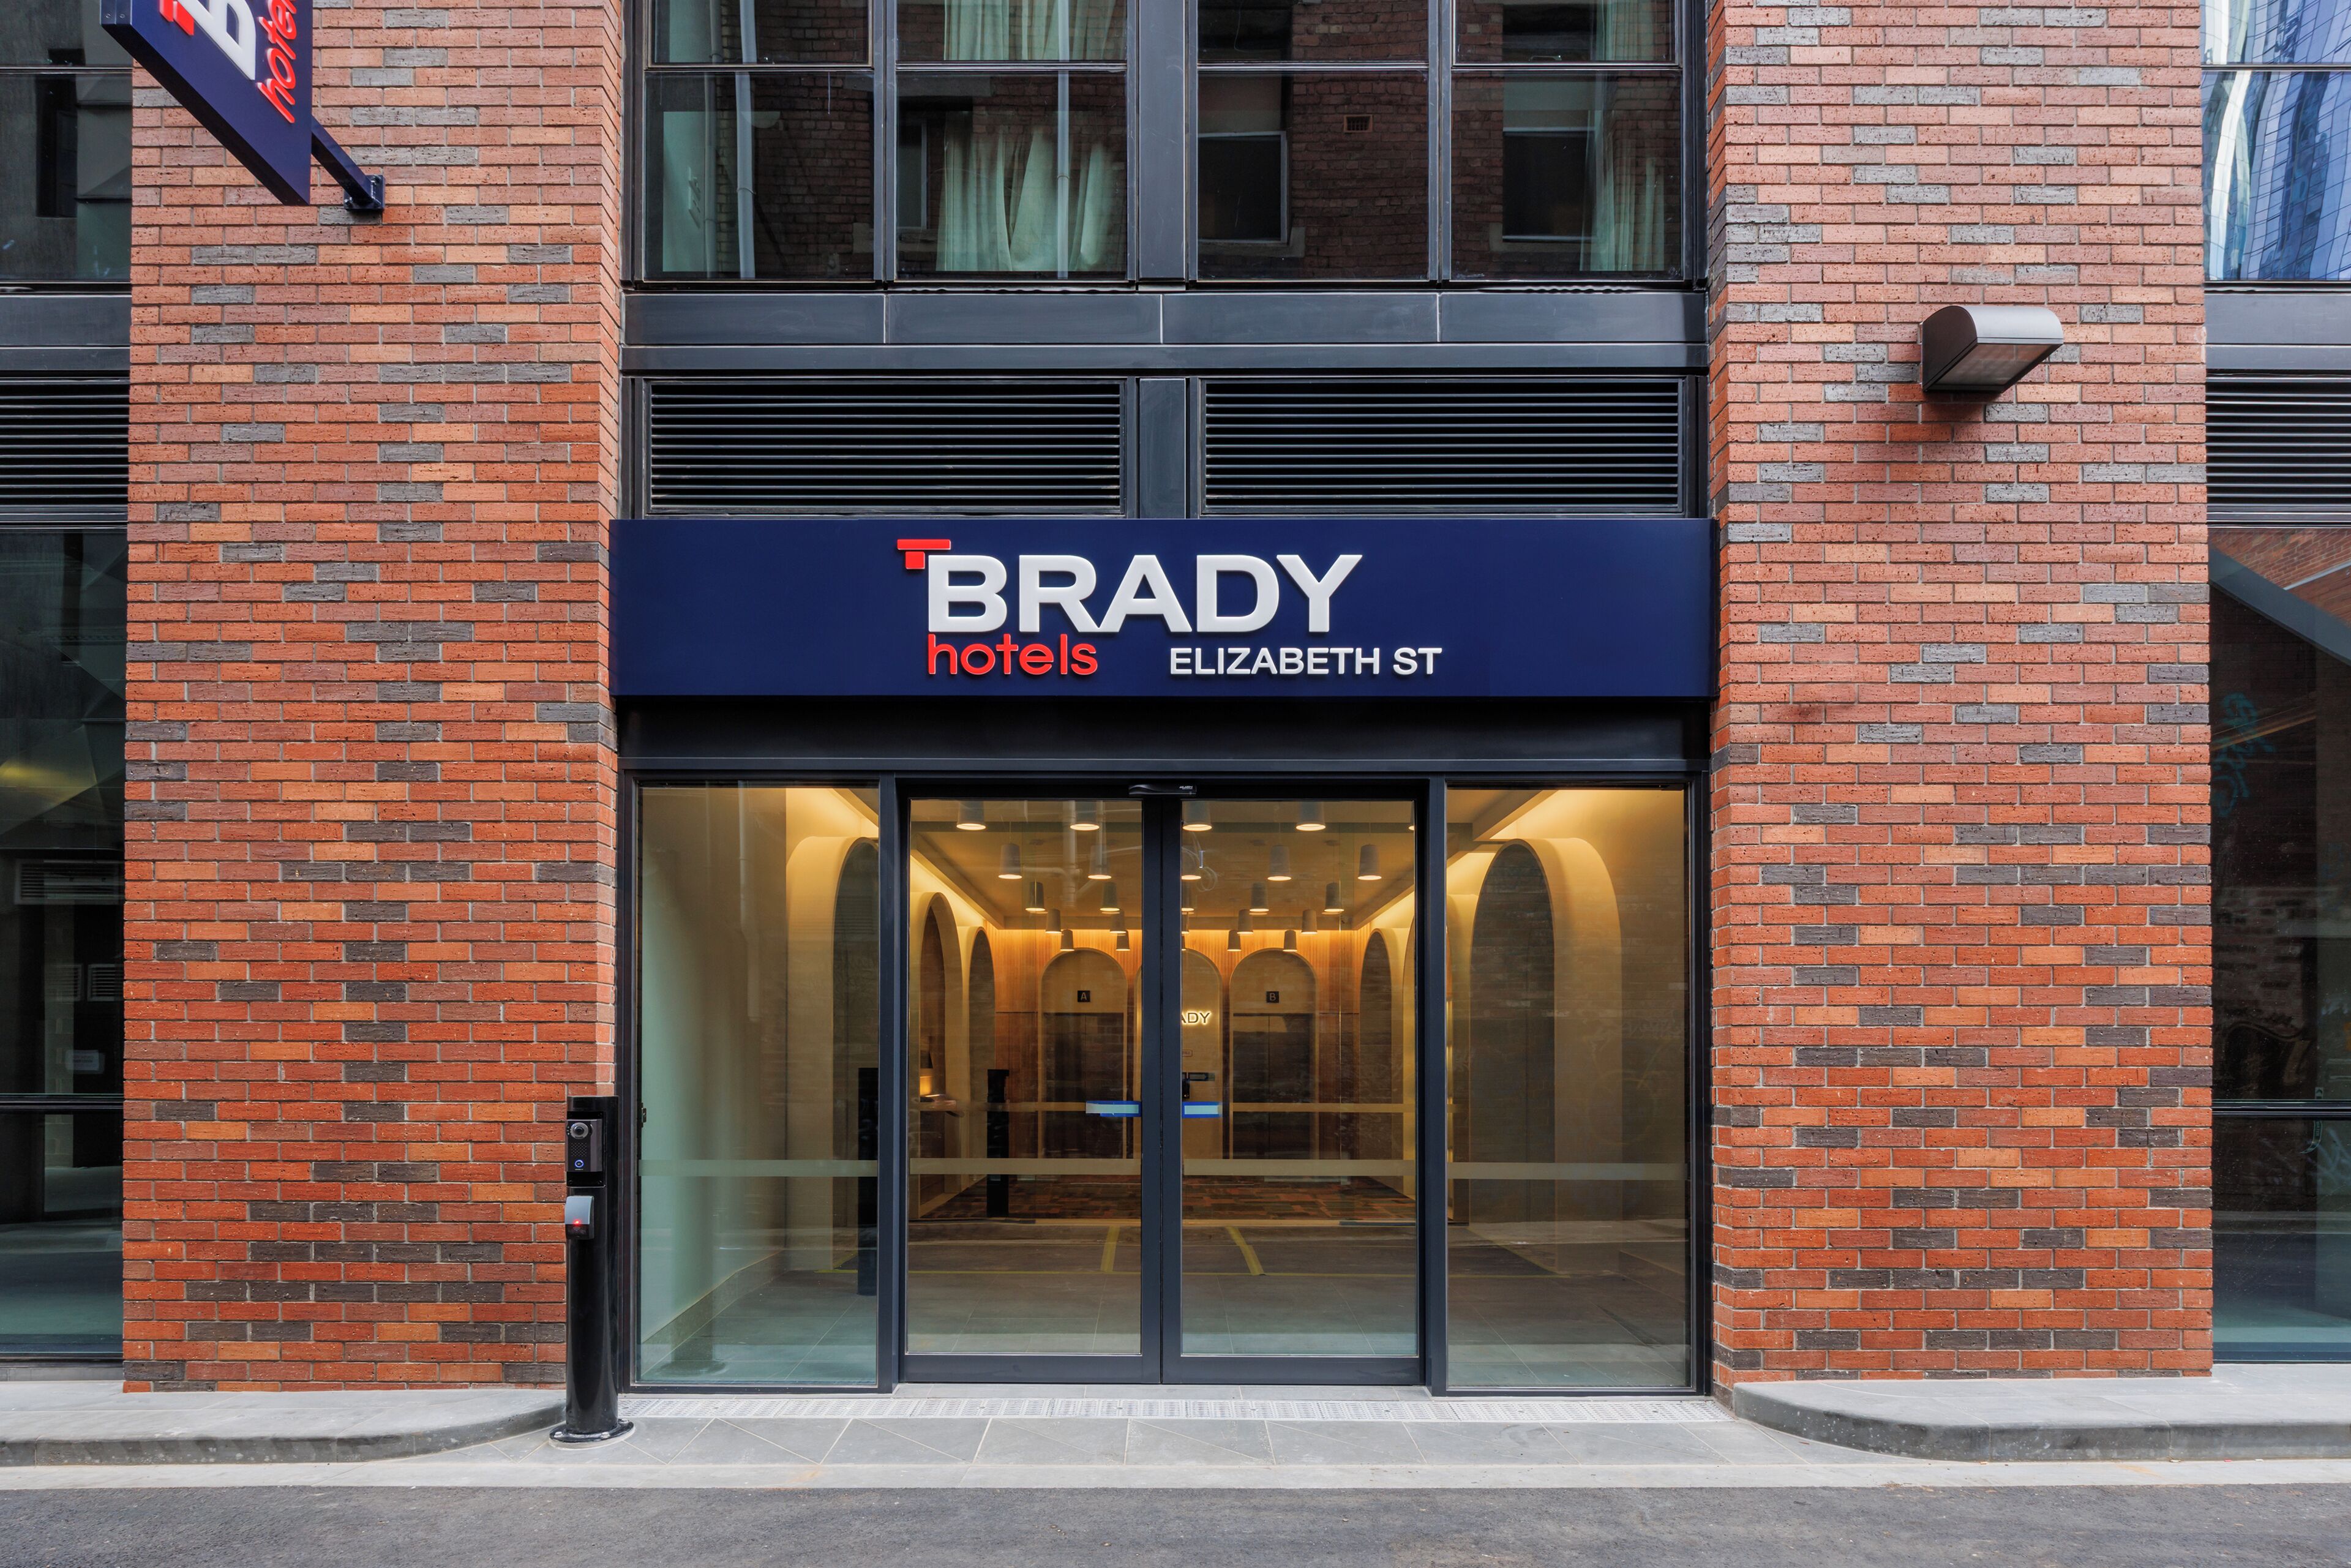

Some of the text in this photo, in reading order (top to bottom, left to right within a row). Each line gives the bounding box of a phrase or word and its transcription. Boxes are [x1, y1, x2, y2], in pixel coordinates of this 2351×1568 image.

[928, 555, 1363, 633] BRADY
[928, 634, 1098, 675] hotels
[1170, 647, 1442, 675] ELIZABETH ST
[1081, 992, 1087, 1001] A
[1269, 992, 1277, 1001] B
